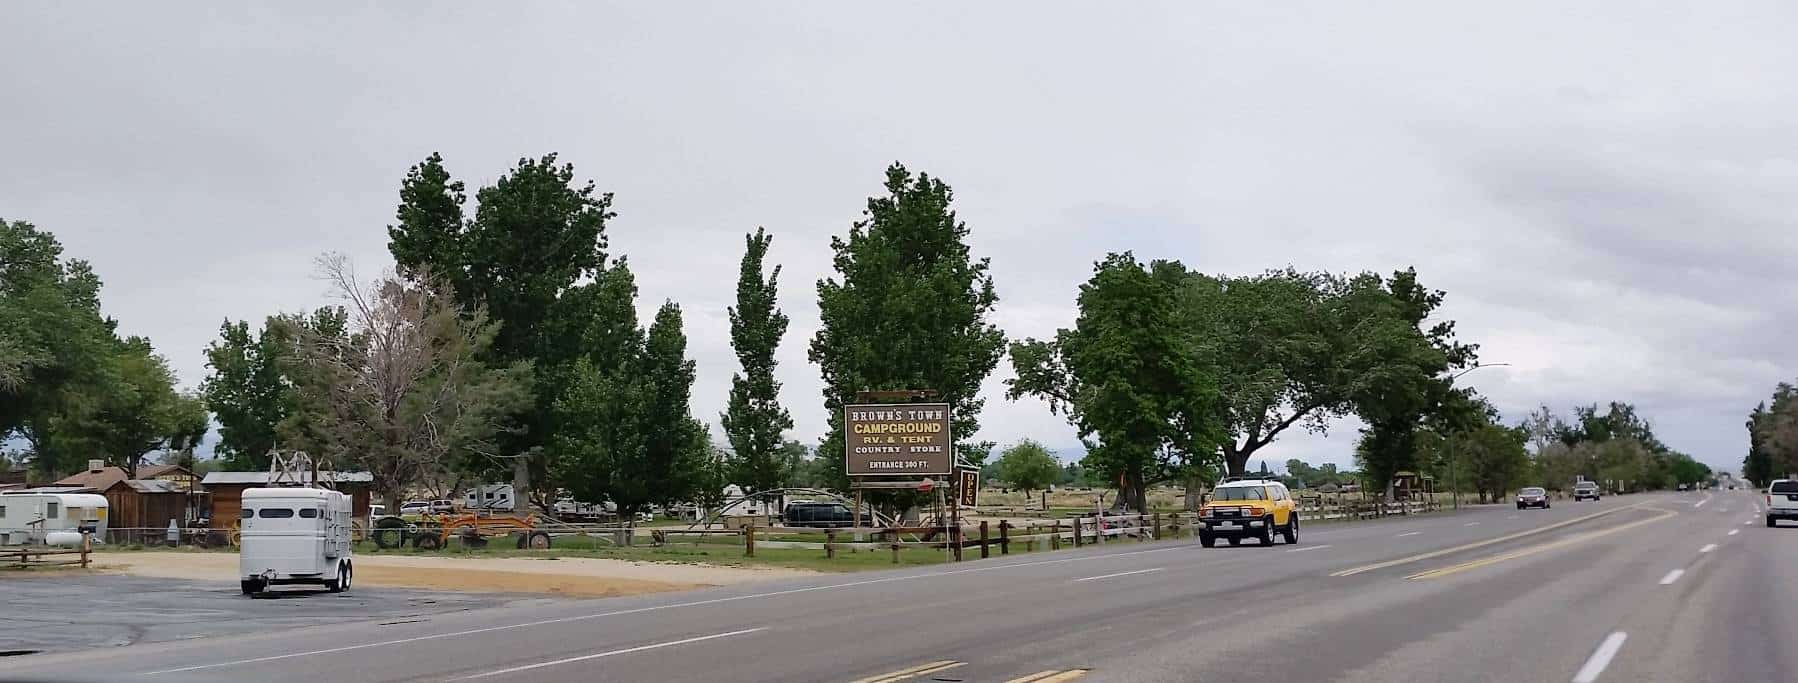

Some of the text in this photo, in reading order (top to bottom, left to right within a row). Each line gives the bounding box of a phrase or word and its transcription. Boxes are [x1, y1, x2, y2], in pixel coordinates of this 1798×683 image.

[852, 408, 943, 421] BROWN'S TOWN
[854, 422, 941, 434] CAMPGROUND
[887, 436, 895, 444] &
[900, 435, 933, 444] TENT
[855, 445, 942, 454] COUNTRY STORE
[869, 461, 904, 469] ENTRANCE
[965, 473, 975, 505] OPEN
